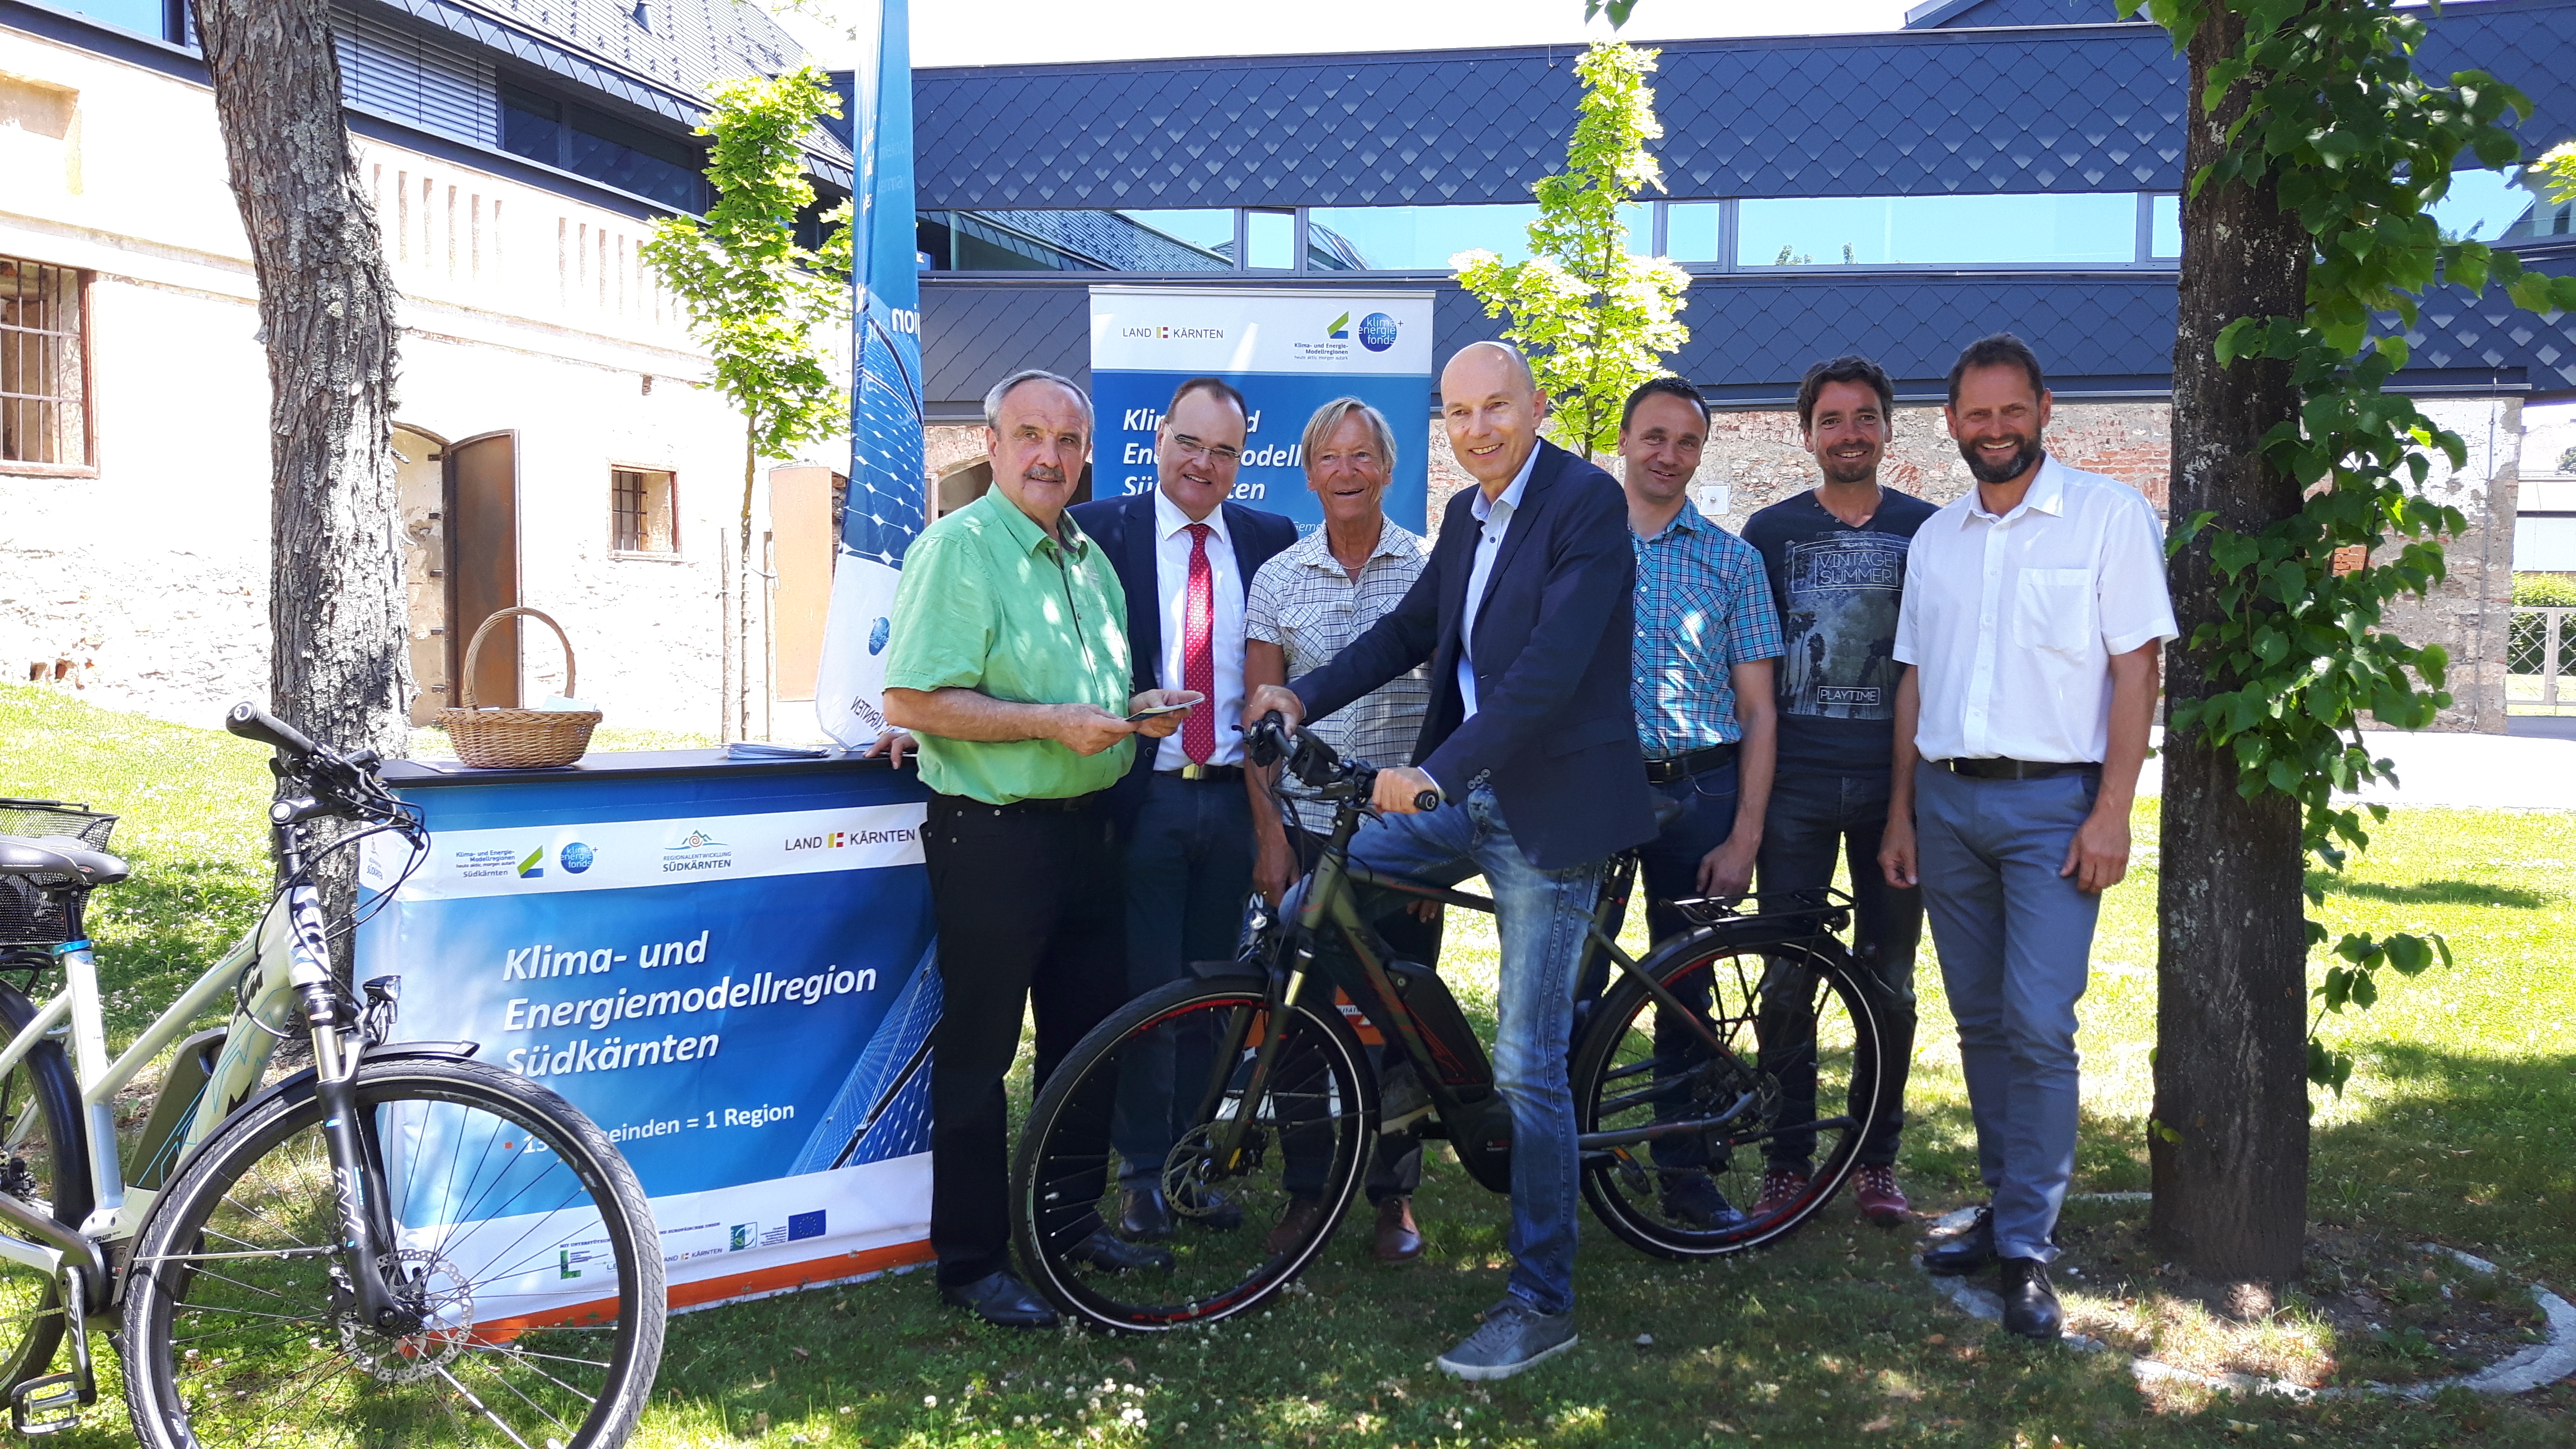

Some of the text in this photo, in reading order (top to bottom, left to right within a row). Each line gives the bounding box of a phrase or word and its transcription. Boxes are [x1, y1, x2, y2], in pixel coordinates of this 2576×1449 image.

[1367, 317, 1395, 327] klima
[1123, 326, 1223, 339] LAND KÄRNTEN
[1358, 326, 1396, 337] energie
[1367, 334, 1395, 345] fonds
[1819, 552, 1893, 569] VINTAGE
[1821, 569, 1892, 584] SUMMER
[1820, 689, 1877, 702] PLAYTIME
[785, 829, 915, 851] LAND KÄRNTEN
[566, 846, 591, 854] klima
[663, 851, 732, 861] REGIONALENTWICKLUNG
[560, 853, 593, 861] energie
[568, 860, 591, 868] fonds
[663, 859, 731, 872] SÜDKÄRNTEN
[503, 930, 709, 981] Klima- und
[503, 965, 878, 1031] Energiemodellregion
[504, 1032, 720, 1078] Südkärnten
[706, 1111, 718, 1129] 1
[724, 1102, 795, 1129] Region
[692, 1248, 722, 1258] KÄRNTEN
